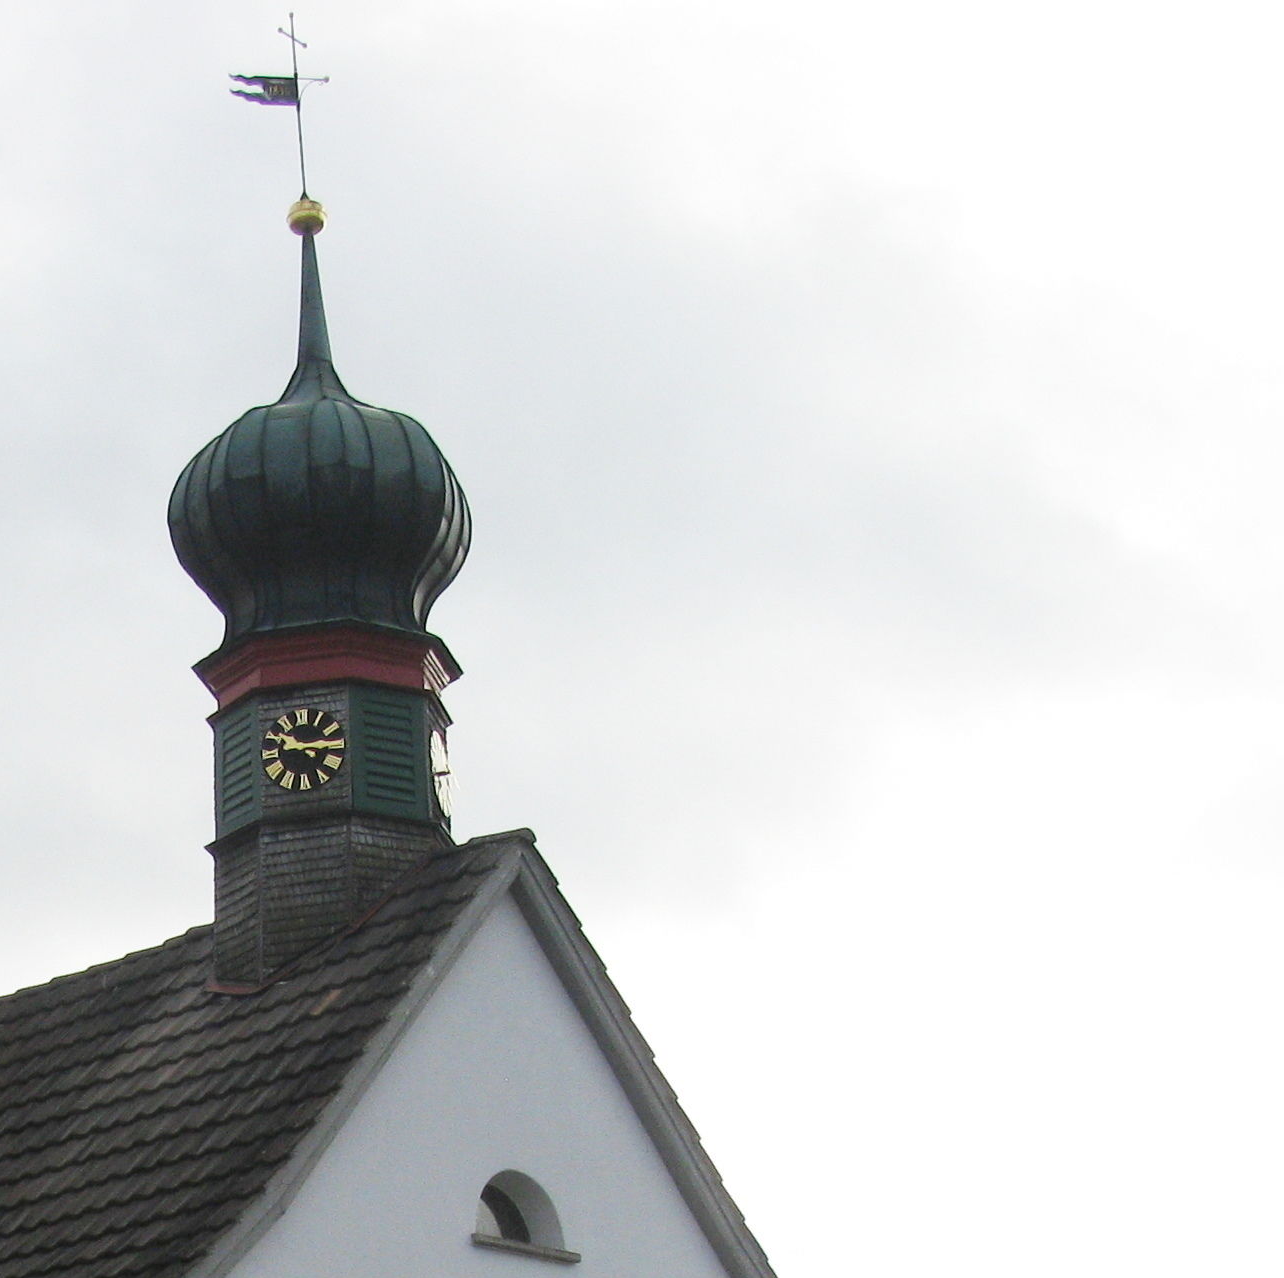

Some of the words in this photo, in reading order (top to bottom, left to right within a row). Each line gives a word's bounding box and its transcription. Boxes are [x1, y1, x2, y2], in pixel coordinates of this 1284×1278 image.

[313, 711, 324, 727] I
[323, 721, 340, 737] II
[299, 773, 312, 791] VI
[316, 768, 330, 784] V
